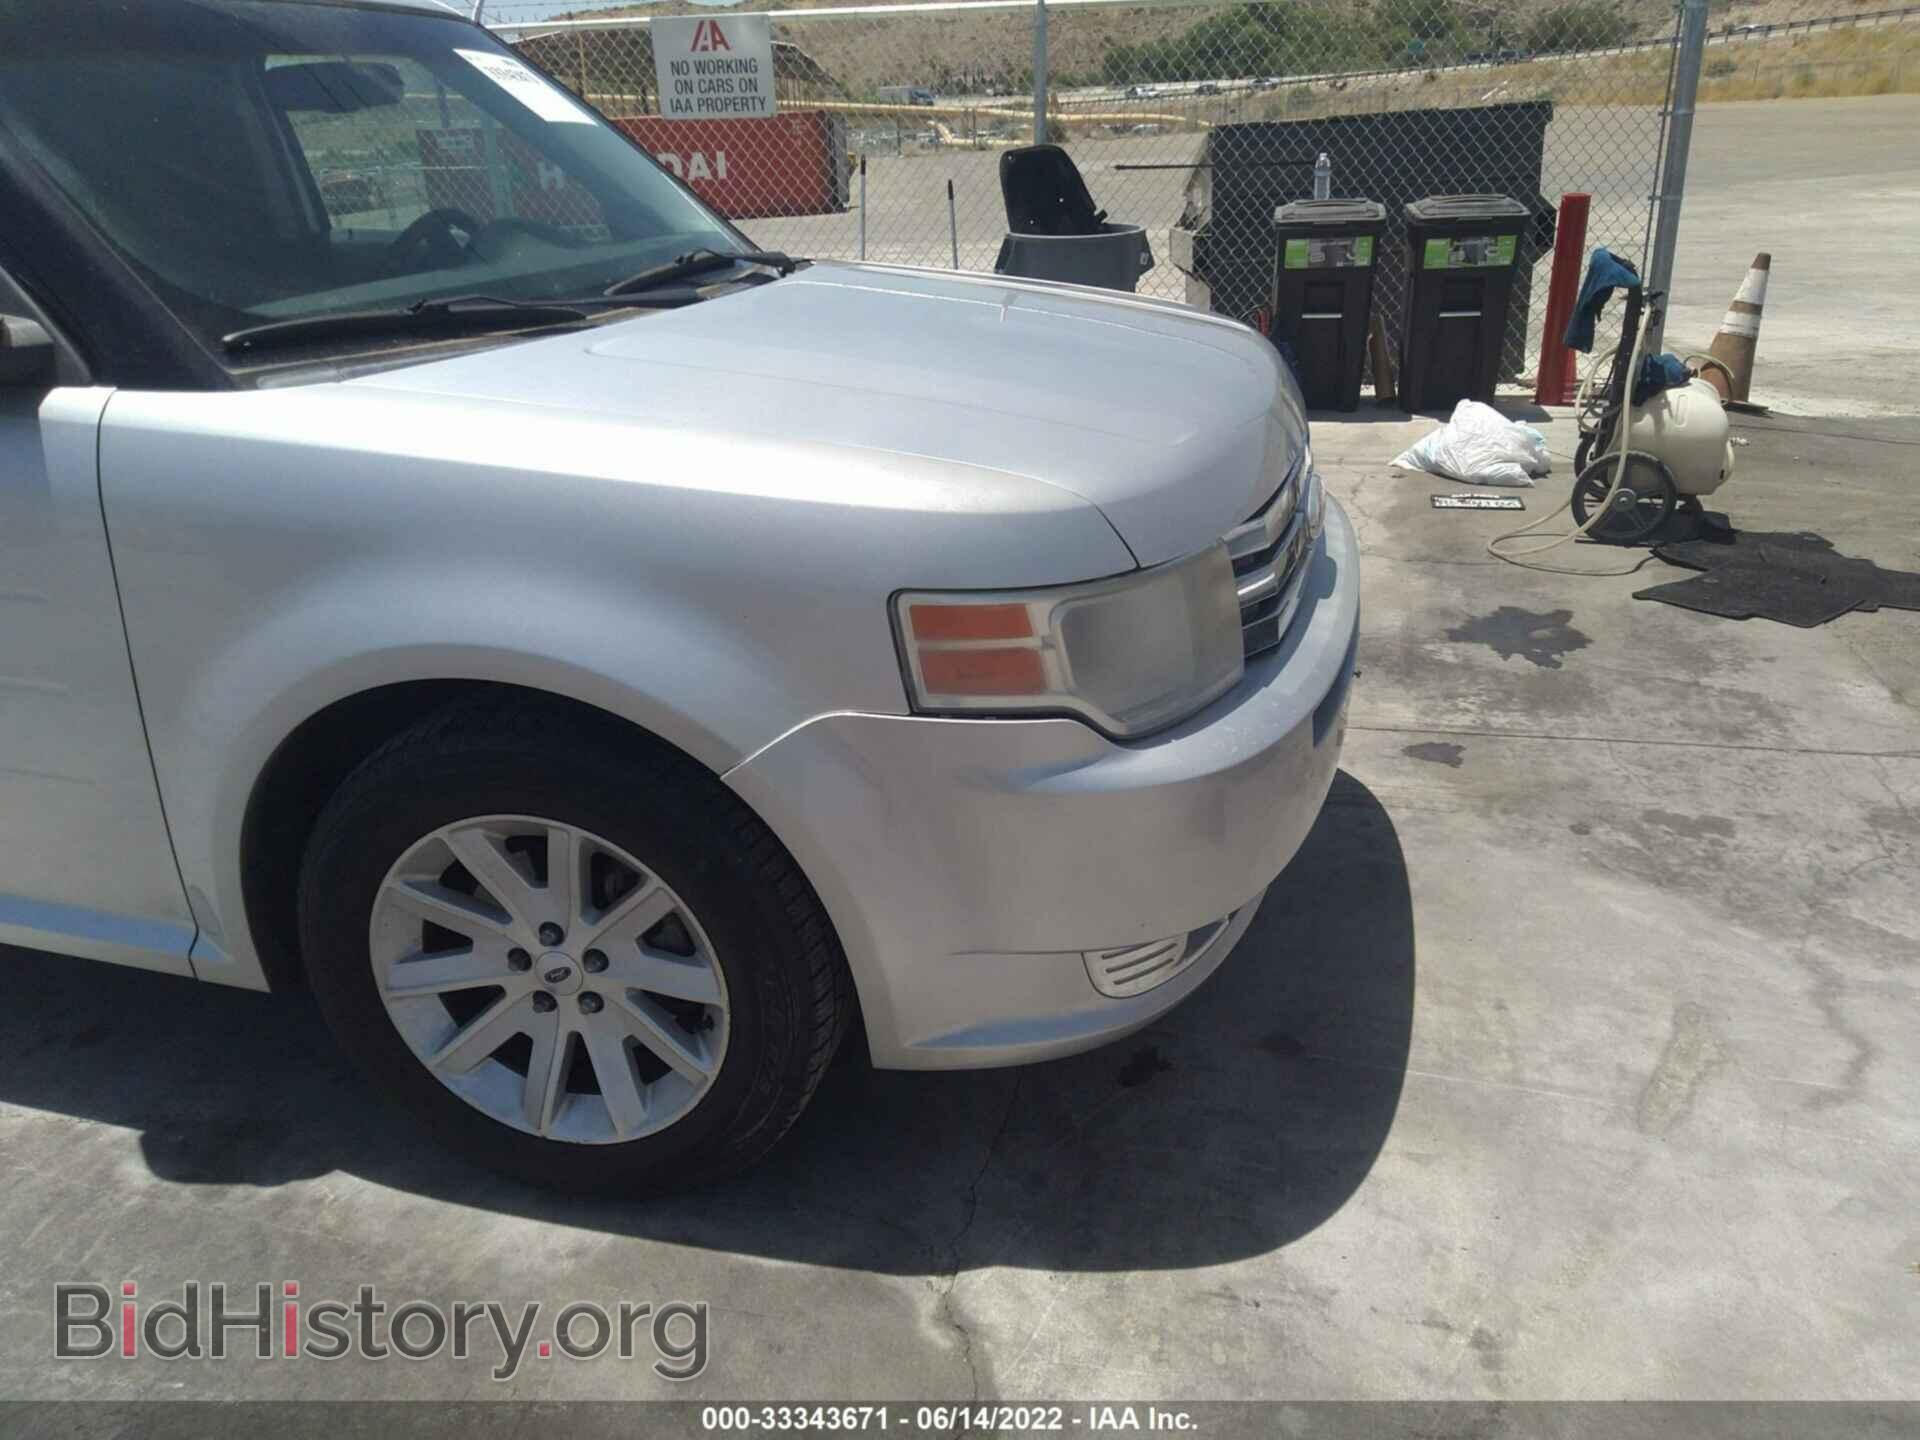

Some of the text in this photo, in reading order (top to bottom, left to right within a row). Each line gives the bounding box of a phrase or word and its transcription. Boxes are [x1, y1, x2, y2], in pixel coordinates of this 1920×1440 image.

[670, 58, 758, 76] NO WORKING
[674, 77, 758, 94] ON CARS ON
[670, 96, 767, 113] IAA PROPERTY
